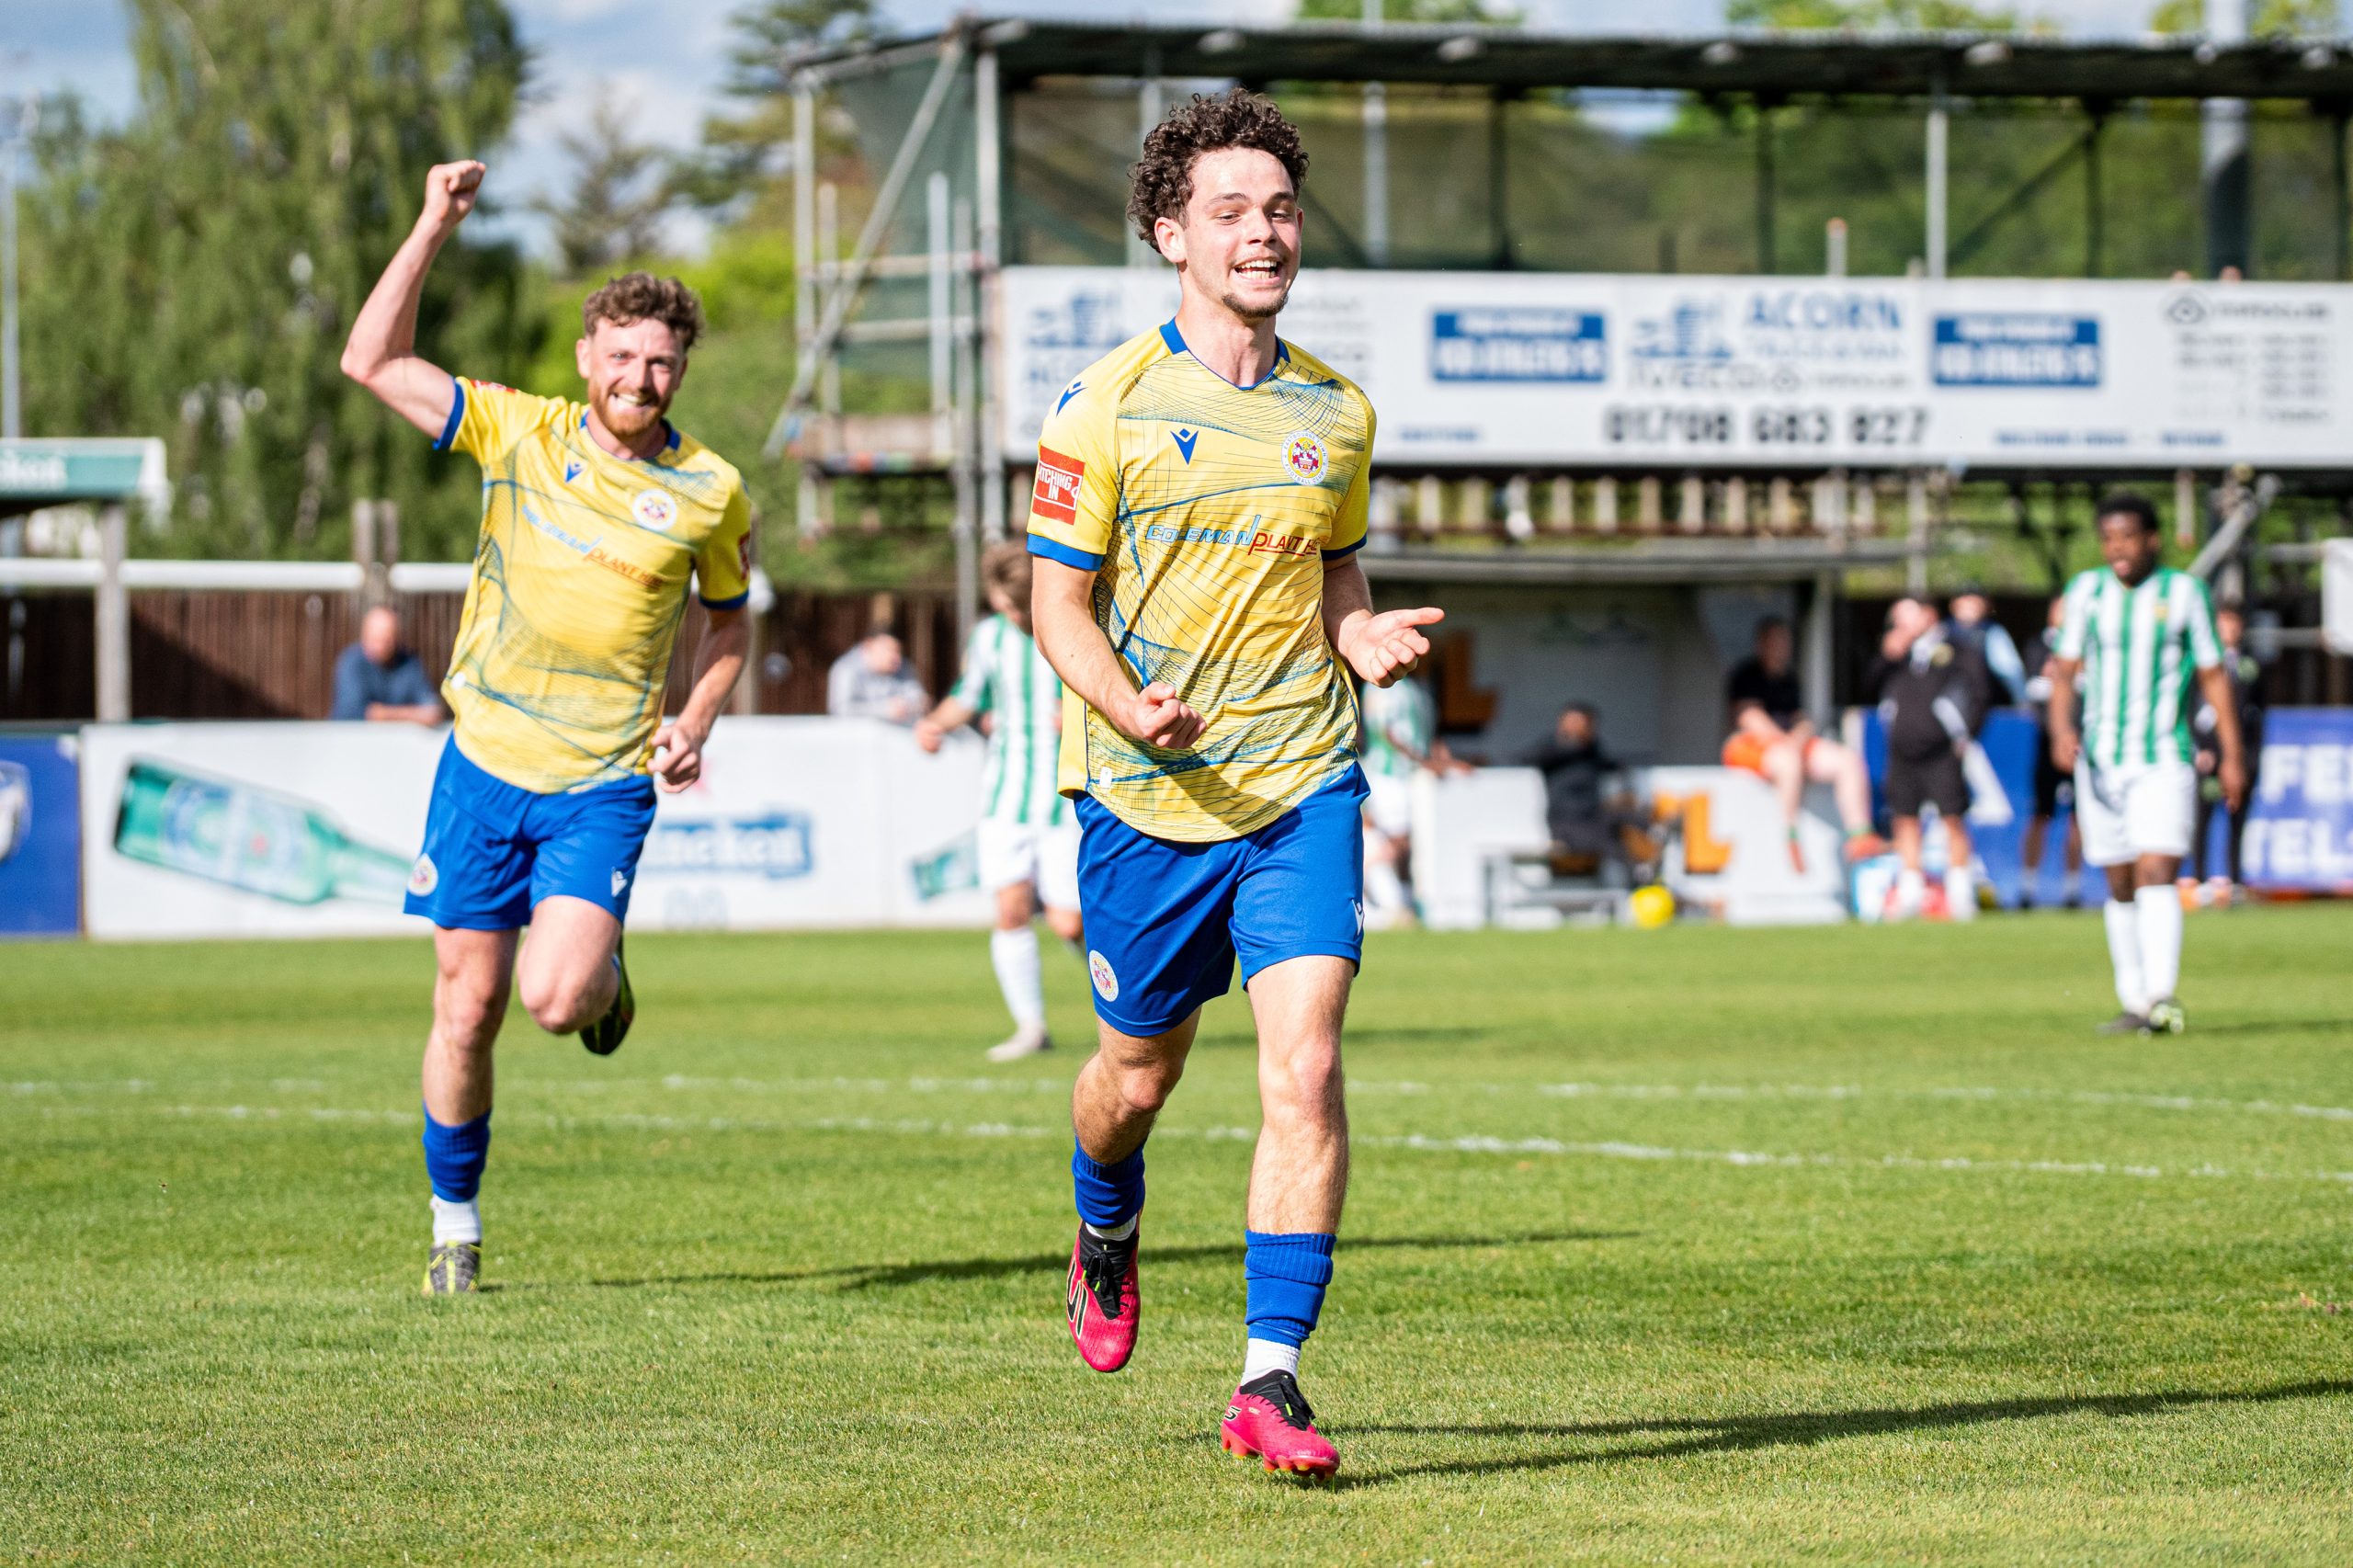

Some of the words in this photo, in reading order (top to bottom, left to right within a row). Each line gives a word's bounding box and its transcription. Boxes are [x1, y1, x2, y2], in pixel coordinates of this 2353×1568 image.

[1745, 292, 1903, 328] ACORN
[1753, 405, 1829, 444] 683
[1849, 405, 1930, 444] 827
[1038, 465, 1074, 492] ITCHING
[1048, 484, 1060, 501] IN
[2260, 744, 2353, 800] FE
